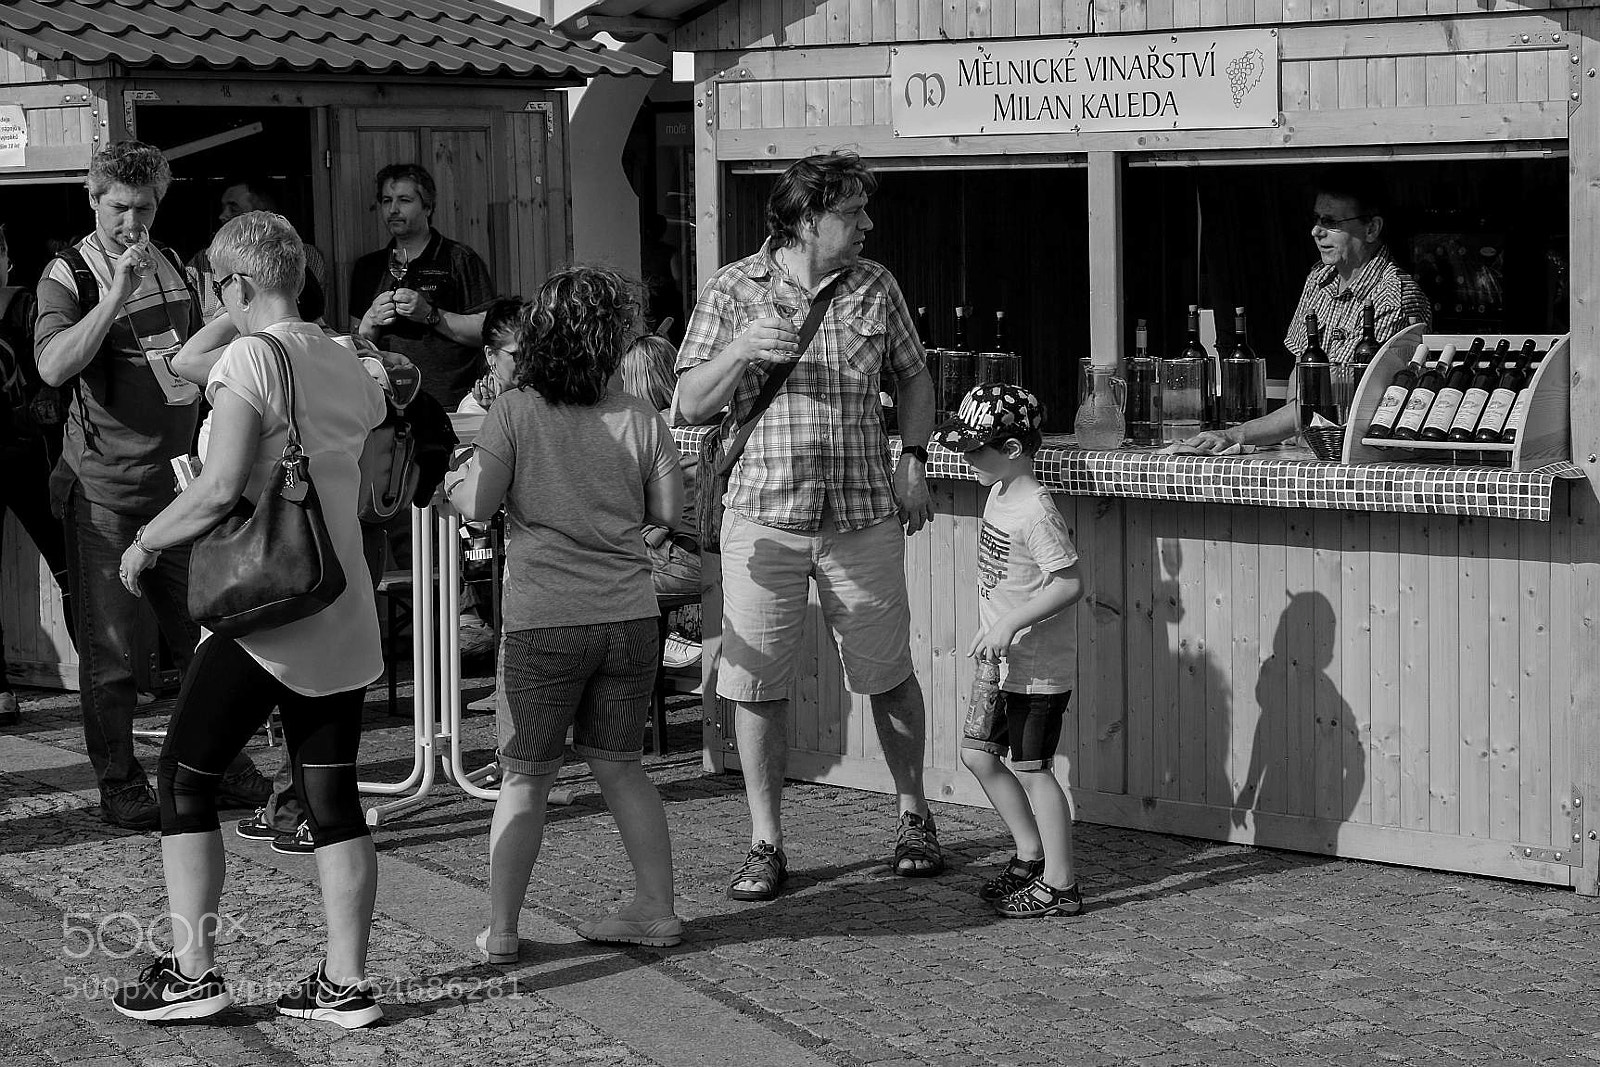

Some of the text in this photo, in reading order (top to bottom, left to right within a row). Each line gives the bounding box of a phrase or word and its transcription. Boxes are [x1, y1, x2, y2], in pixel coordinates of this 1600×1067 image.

[957, 41, 1217, 87] MĚLNICKÉ VINAŘSTVÍ
[993, 91, 1179, 122] MILAN KALEDA
